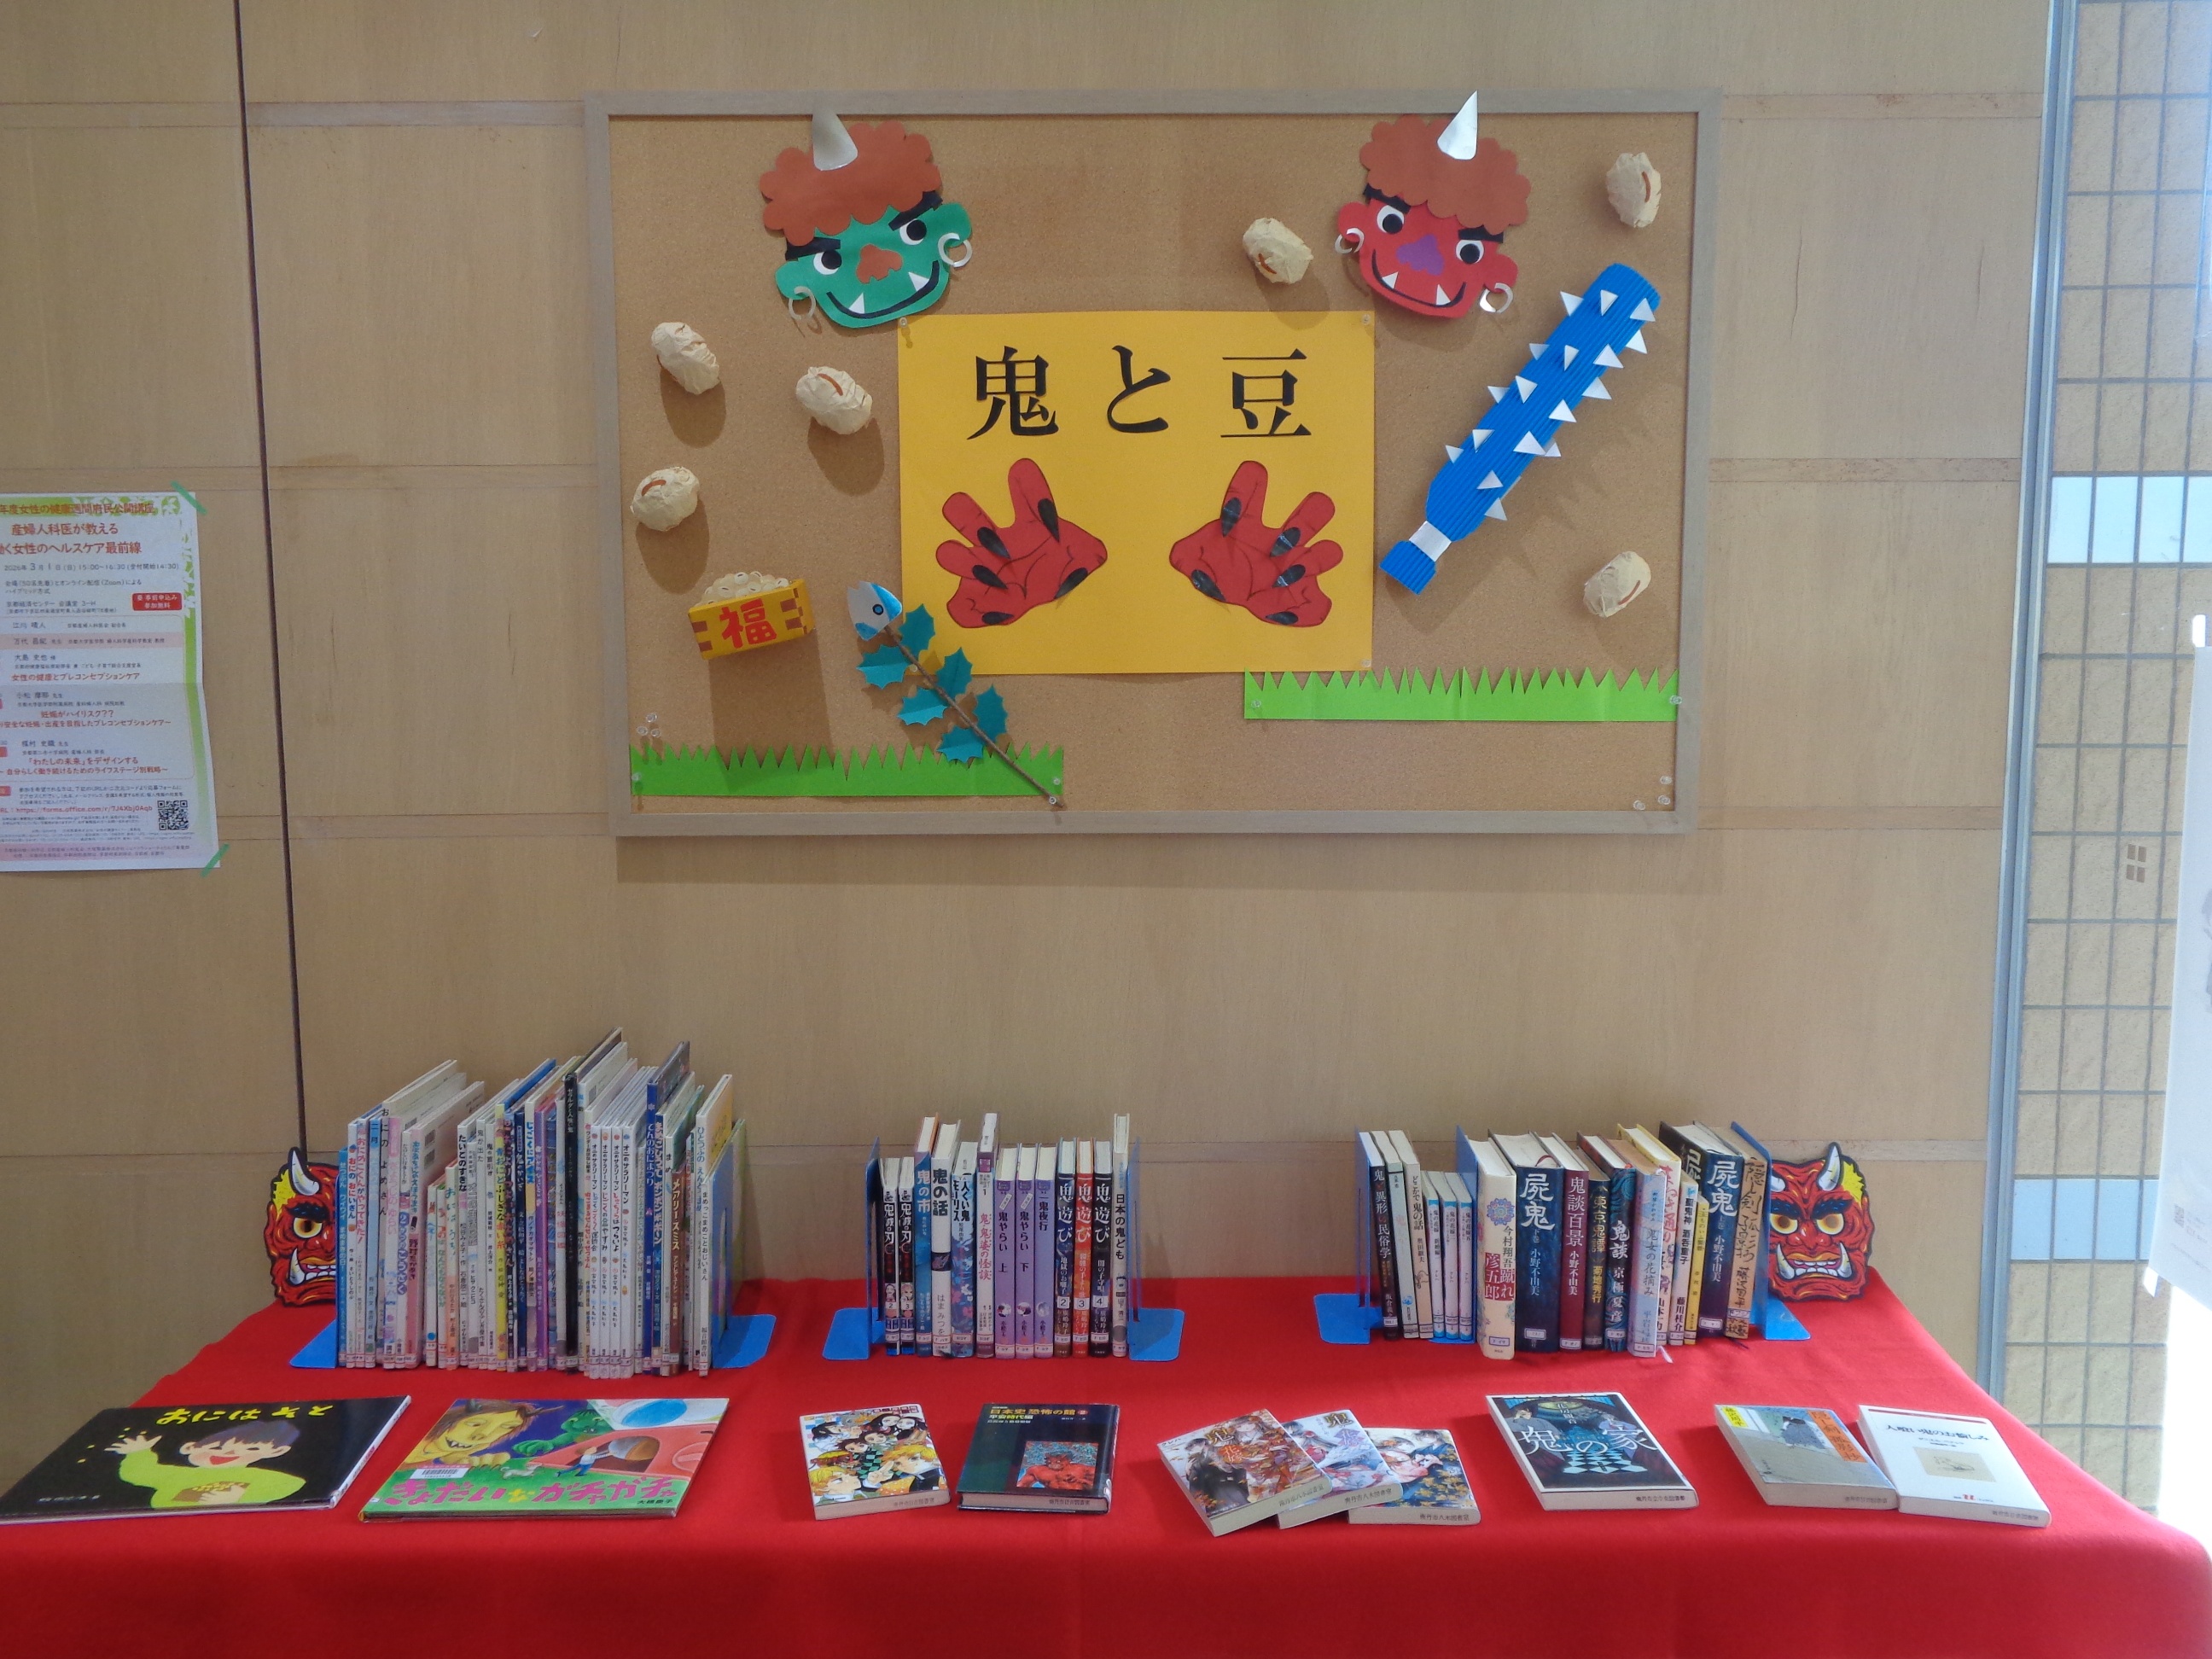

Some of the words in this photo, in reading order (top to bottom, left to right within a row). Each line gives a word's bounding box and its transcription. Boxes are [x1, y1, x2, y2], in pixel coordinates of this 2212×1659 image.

[11, 522, 119, 536] 産婦人科医が教える
[719, 598, 777, 649] 福
[348, 1157, 357, 1179] おにの
[458, 1133, 467, 1192] たいこのすきな
[917, 1170, 931, 1214] 鬼の市
[933, 1168, 949, 1216] 鬼の話
[952, 1179, 961, 1222] モーリス
[961, 1180, 970, 1222] 人くい鬼
[1519, 1173, 1556, 1231] 屍鬼
[1708, 1160, 1740, 1217] 屍鬼
[672, 1181, 680, 1251] メアリー・スミス
[884, 1204, 895, 1244] 鬼滅の刃
[900, 1203, 912, 1243] 鬼滅の刃
[998, 1211, 1009, 1252] 鬼やらい
[1020, 1211, 1029, 1251] 鬼やらい
[1039, 1196, 1049, 1231] 一鬼夜行
[1115, 1194, 1126, 1260] 日本の鬼ども
[1566, 1176, 1586, 1247] 鬼談百景
[1592, 1195, 1607, 1253] 東京鬼譚
[1502, 1225, 1514, 1268] 今村翔吾
[1610, 1220, 1629, 1260] 鬼談
[1712, 1234, 1725, 1282] 小野不由美
[998, 1263, 1009, 1273] 上
[1020, 1262, 1029, 1272] 下
[1484, 1253, 1500, 1301] 彦五郎
[1530, 1248, 1541, 1296] 小野不由美
[1569, 1250, 1580, 1296] 小野不由美
[1643, 1229, 1659, 1296] 鬼女の花摘み
[1061, 1297, 1067, 1307] 2
[1078, 1299, 1085, 1307] 3
[1096, 1297, 1103, 1306] 4
[1592, 1266, 1603, 1304] 菊地秀行
[937, 1294, 946, 1336] はまみつを
[1517, 1424, 1659, 1456] 鬼の家
